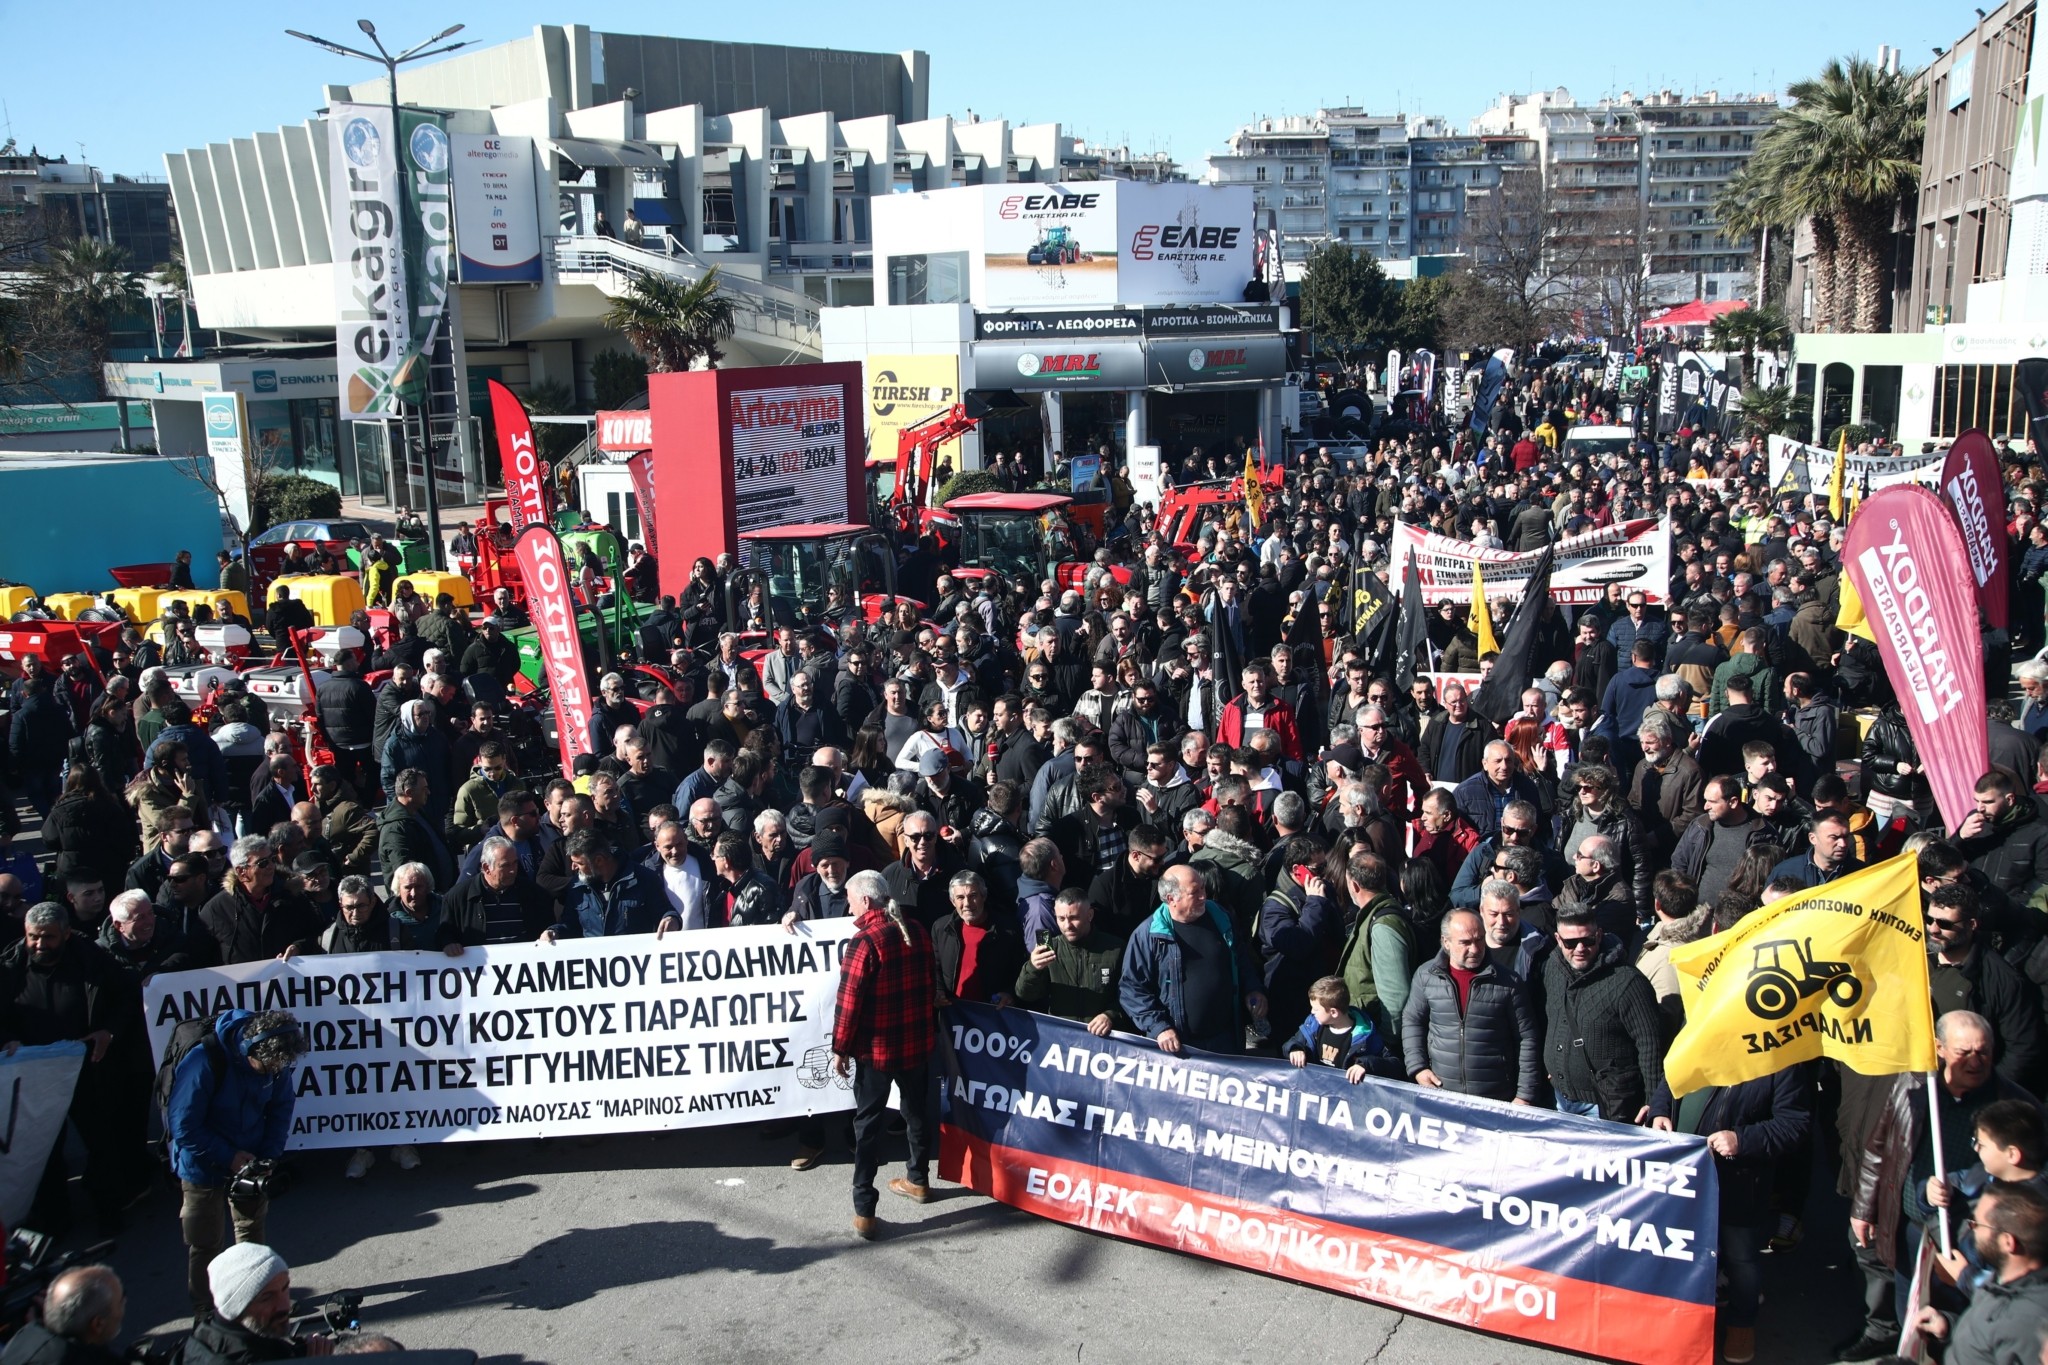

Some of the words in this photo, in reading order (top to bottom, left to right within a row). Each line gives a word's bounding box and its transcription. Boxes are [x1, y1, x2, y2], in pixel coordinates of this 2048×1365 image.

[808, 51, 869, 66] HELEXPO
[467, 151, 519, 159] alteregomedia
[493, 206, 503, 217] in
[1024, 194, 1100, 210] ΕΛΒΕ
[490, 221, 507, 229] one
[1160, 226, 1240, 248] ΕΛΒΕ
[1158, 253, 1207, 261] ΕΛΑΣΤΙΚΑ
[389, 247, 404, 356] DEKAGRO
[983, 320, 1045, 333] ΦΟΡΤΗΓΑ
[1056, 317, 1137, 331] ΛΕΩΦΟΡΕΙΑ
[1151, 316, 1199, 327] ΑΓΡΟΤΙΚΑ
[1206, 313, 1273, 325] ΒΙΟΜΗΧΑΝΙΚΑ
[1040, 353, 1100, 373] MRL
[1206, 349, 1247, 368] MRL
[280, 374, 325, 385] ΕΘΝΙΚΗ
[731, 395, 840, 432] Artozyma
[737, 454, 777, 480] 24-26
[782, 451, 799, 475] 02
[804, 446, 836, 470] 2024
[1434, 556, 1466, 569] ΜΕΤΡΑ
[1611, 545, 1654, 558] ΑΓΡΟΤΙΑ
[1436, 570, 1457, 579] ΣΤΗΝ
[1553, 589, 1572, 603] ΤΟ
[155, 971, 408, 1027] ΑΝΑΠΛΗΡΩΣΗ
[416, 966, 485, 1003] ΤΟΥ
[493, 954, 652, 995] ΧΑΜΕΝΟΥ
[299, 1018, 383, 1052] ΙΩΣΗ
[391, 1014, 461, 1047] ΤΟΥ
[469, 1003, 617, 1044] ΚΟΣΤΟΥΣ
[625, 990, 807, 1033] ΠΑΡΑΓΩΓΗΣ
[289, 1058, 477, 1098] ΑΤΩΤΑΤΕΣ
[486, 1043, 692, 1088] ΕΓΓΥΗΜΕΝΕΣ
[698, 1037, 794, 1074] ΤΙΜΕΣ
[952, 1024, 1031, 1065] 100%
[1040, 1043, 1290, 1118] ΑΠΟΖΗΜΕΙΩΣΗ
[1297, 1091, 1354, 1131] ΓΙΑ
[1365, 1106, 1466, 1153] ΟΛΕΣ
[292, 1110, 400, 1135] ΑΓΡΟΤΙΚΟΣ
[405, 1106, 502, 1129] ΣΥΛΛΟΓΟΣ
[506, 1100, 592, 1124] ΝΑΟΥΣΑΣ
[954, 1076, 1078, 1128] ΑΓΩΝΑΣ
[1084, 1104, 1136, 1141] ΓΙΑ
[1144, 1119, 1196, 1154] ΝΑ
[1203, 1132, 1388, 1194] ΜΕΙΝΟΥΜΕ
[1477, 1189, 1588, 1238] ΤΟΠΟ
[1596, 1213, 1695, 1262] ΜΑΣ
[1026, 1168, 1138, 1219] ΕΟΑΣΚ
[1171, 1201, 1357, 1272] ΑΓΡΟΤΙΚΟΙ
[1367, 1248, 1557, 1322] ΣΥΛΛΟΓΟΙ
